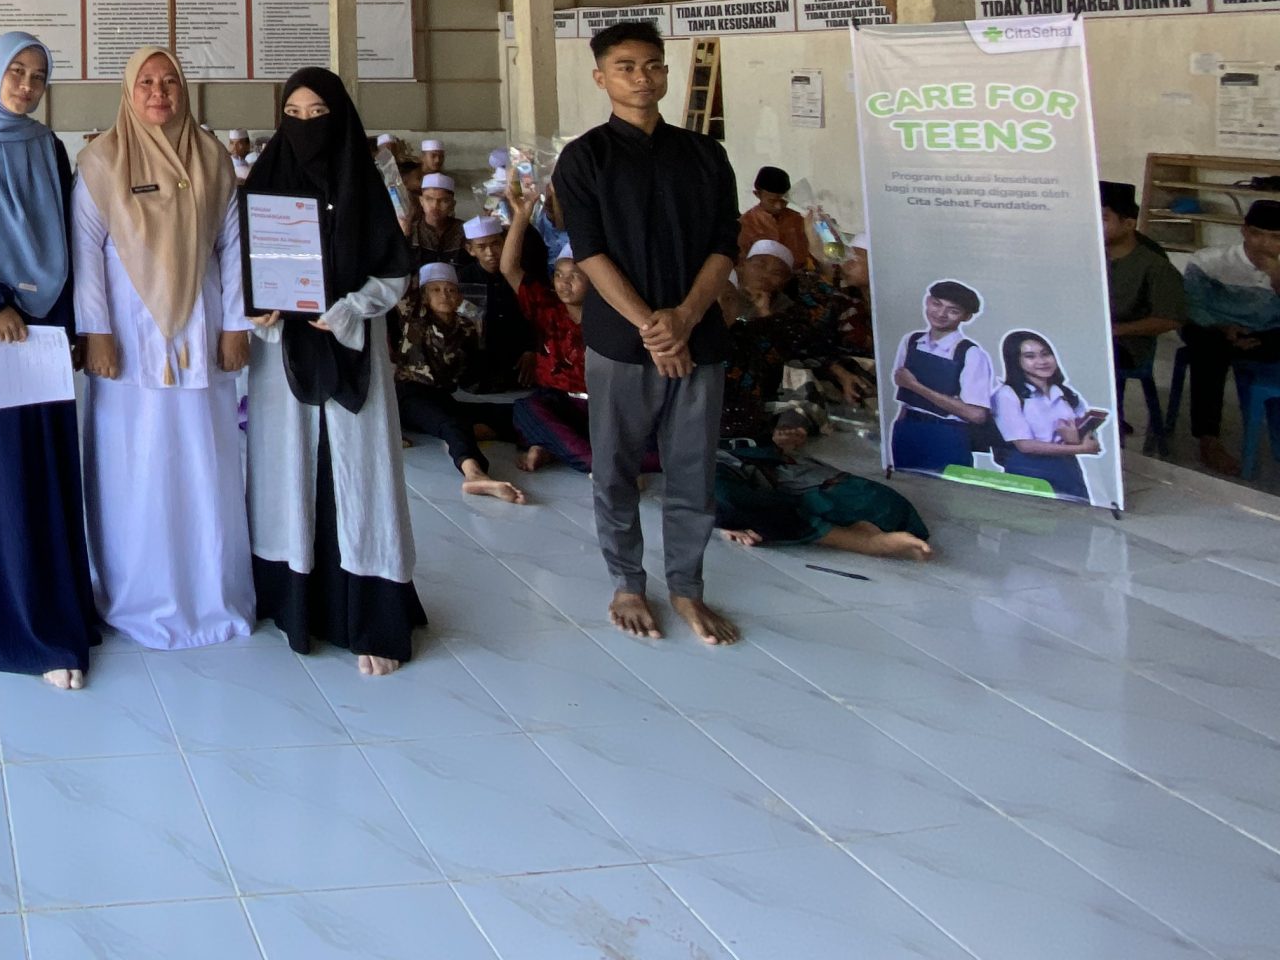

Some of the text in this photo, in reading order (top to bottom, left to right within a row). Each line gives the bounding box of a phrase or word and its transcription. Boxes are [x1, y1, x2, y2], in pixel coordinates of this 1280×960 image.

[676, 0, 790, 18] TIDAK ADA KESUKSESAN
[804, 0, 872, 12] MENGHARAPKAN
[806, 11, 828, 20] TIDAK
[830, 9, 866, 18] BERBUDI
[688, 16, 776, 32] TANPA KESUSAHAN
[826, 20, 848, 28] TIDAK
[1004, 26, 1072, 39] CitaSehat
[866, 84, 1078, 118] CARE FOR
[891, 120, 1055, 152] TEENS
[892, 172, 1059, 185] Program edukasi kesehatan
[884, 184, 910, 194] bagi
[912, 185, 952, 196] remaja
[956, 187, 986, 198] yang
[989, 188, 1038, 199] digagas
[907, 196, 1051, 211] Cita Sehat Foundation.
